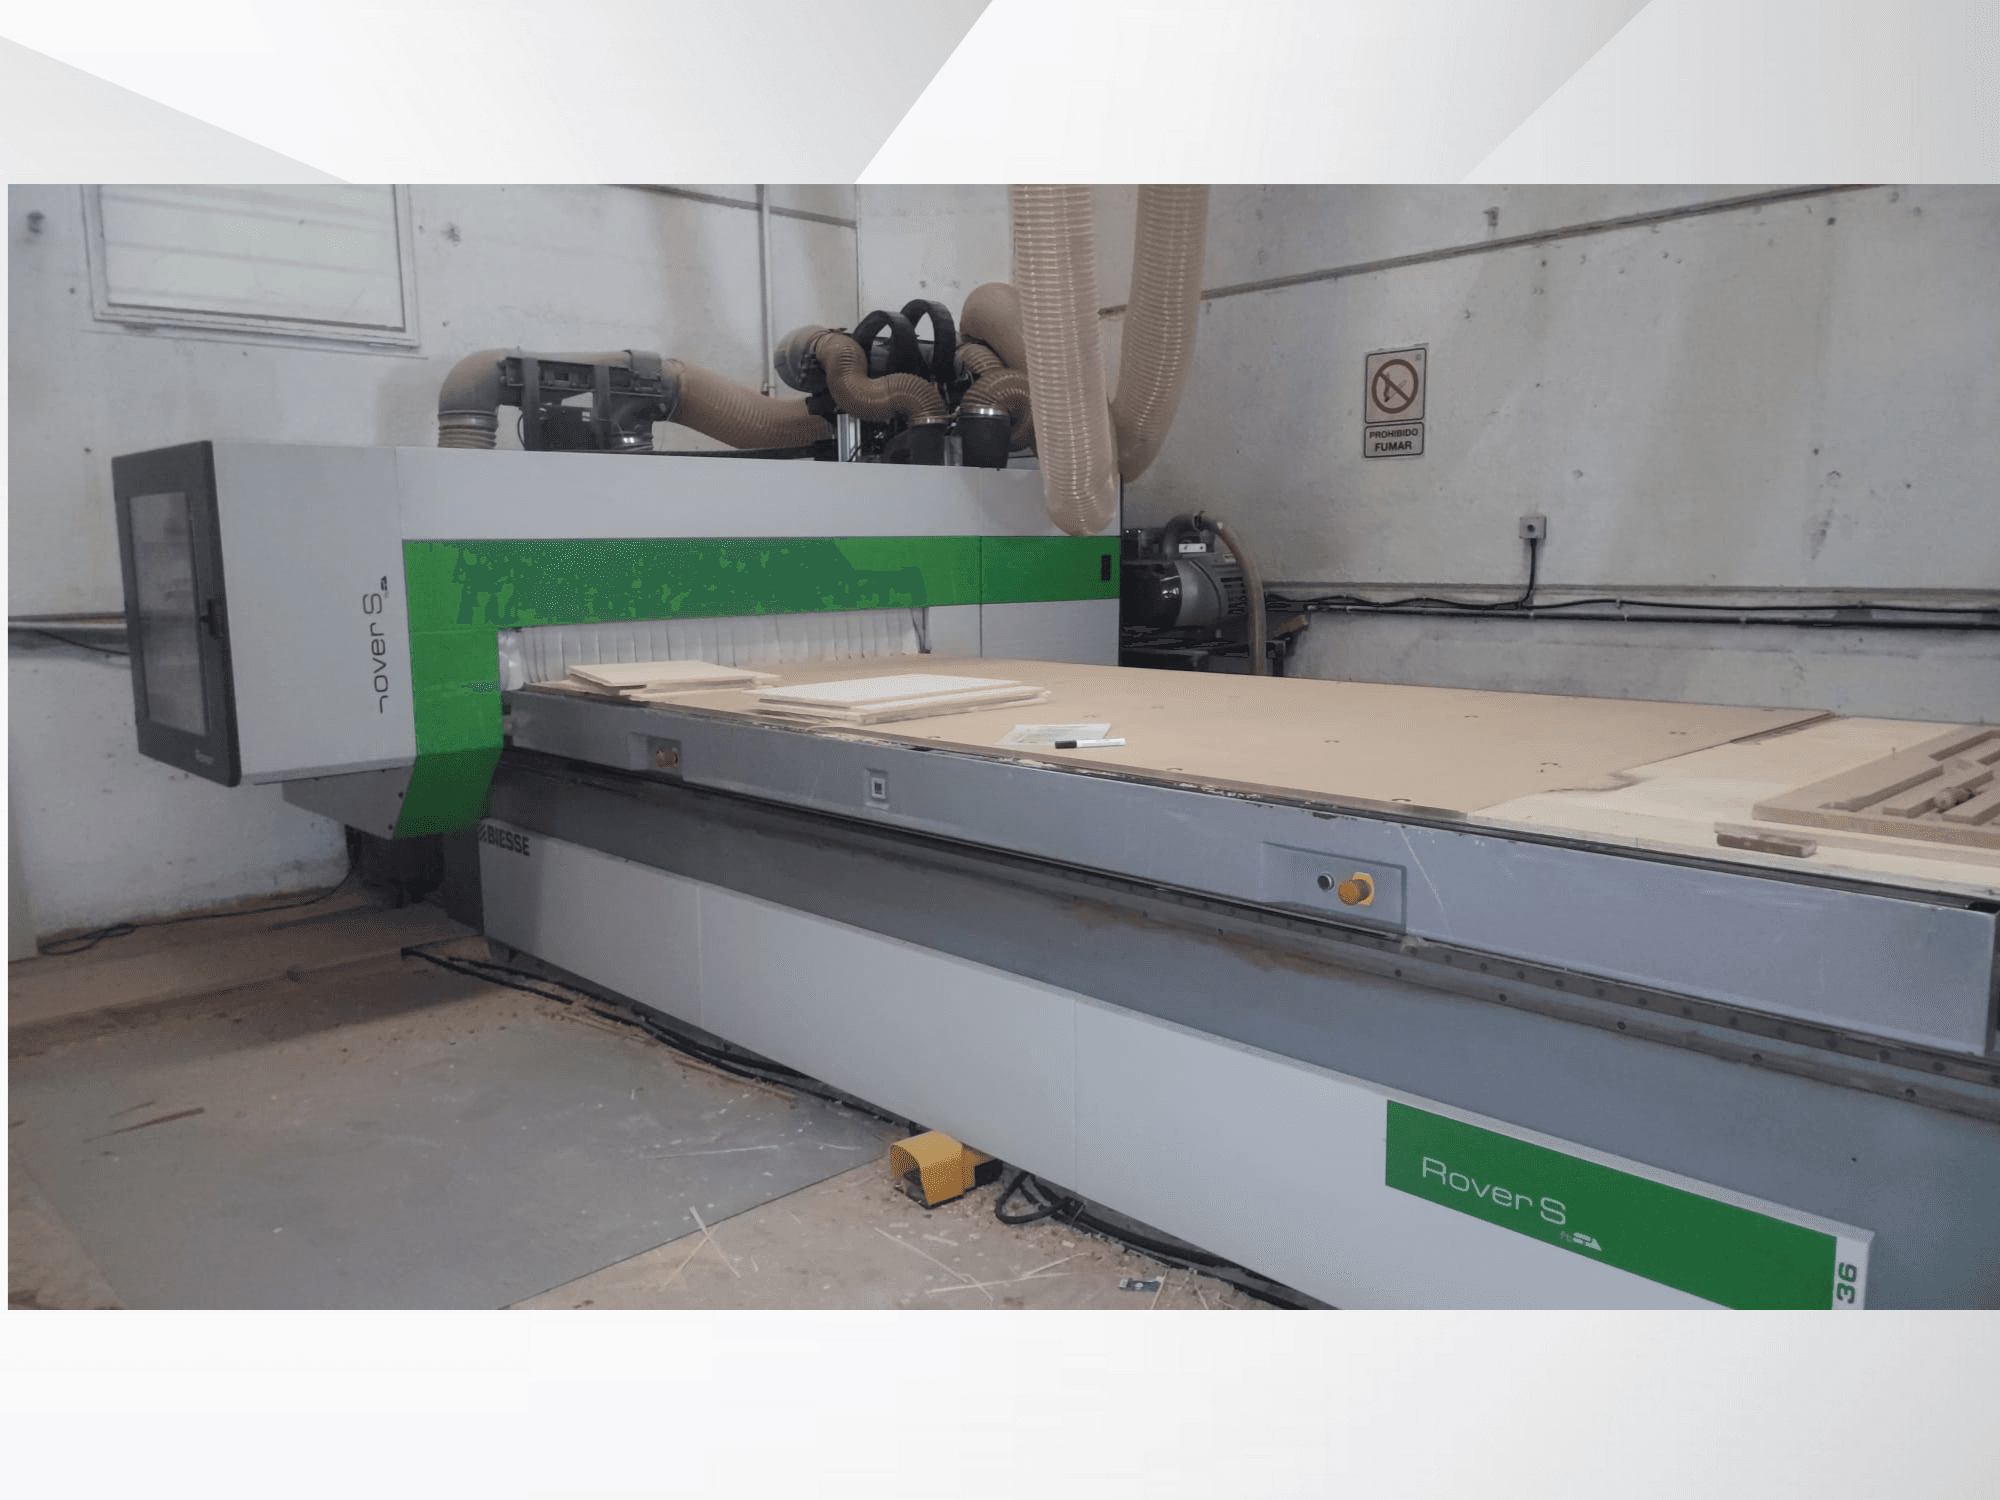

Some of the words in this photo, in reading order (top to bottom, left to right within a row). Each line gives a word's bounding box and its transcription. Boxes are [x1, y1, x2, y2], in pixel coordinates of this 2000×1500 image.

[1369, 428, 1419, 439] PROHIBIDO
[1375, 440, 1412, 452] FUMAR
[362, 593, 383, 615] S
[487, 825, 530, 857] BIESSE
[1421, 1156, 1533, 1211] Rover
[1539, 1196, 1567, 1226] S
[1836, 1261, 1858, 1304] 36
